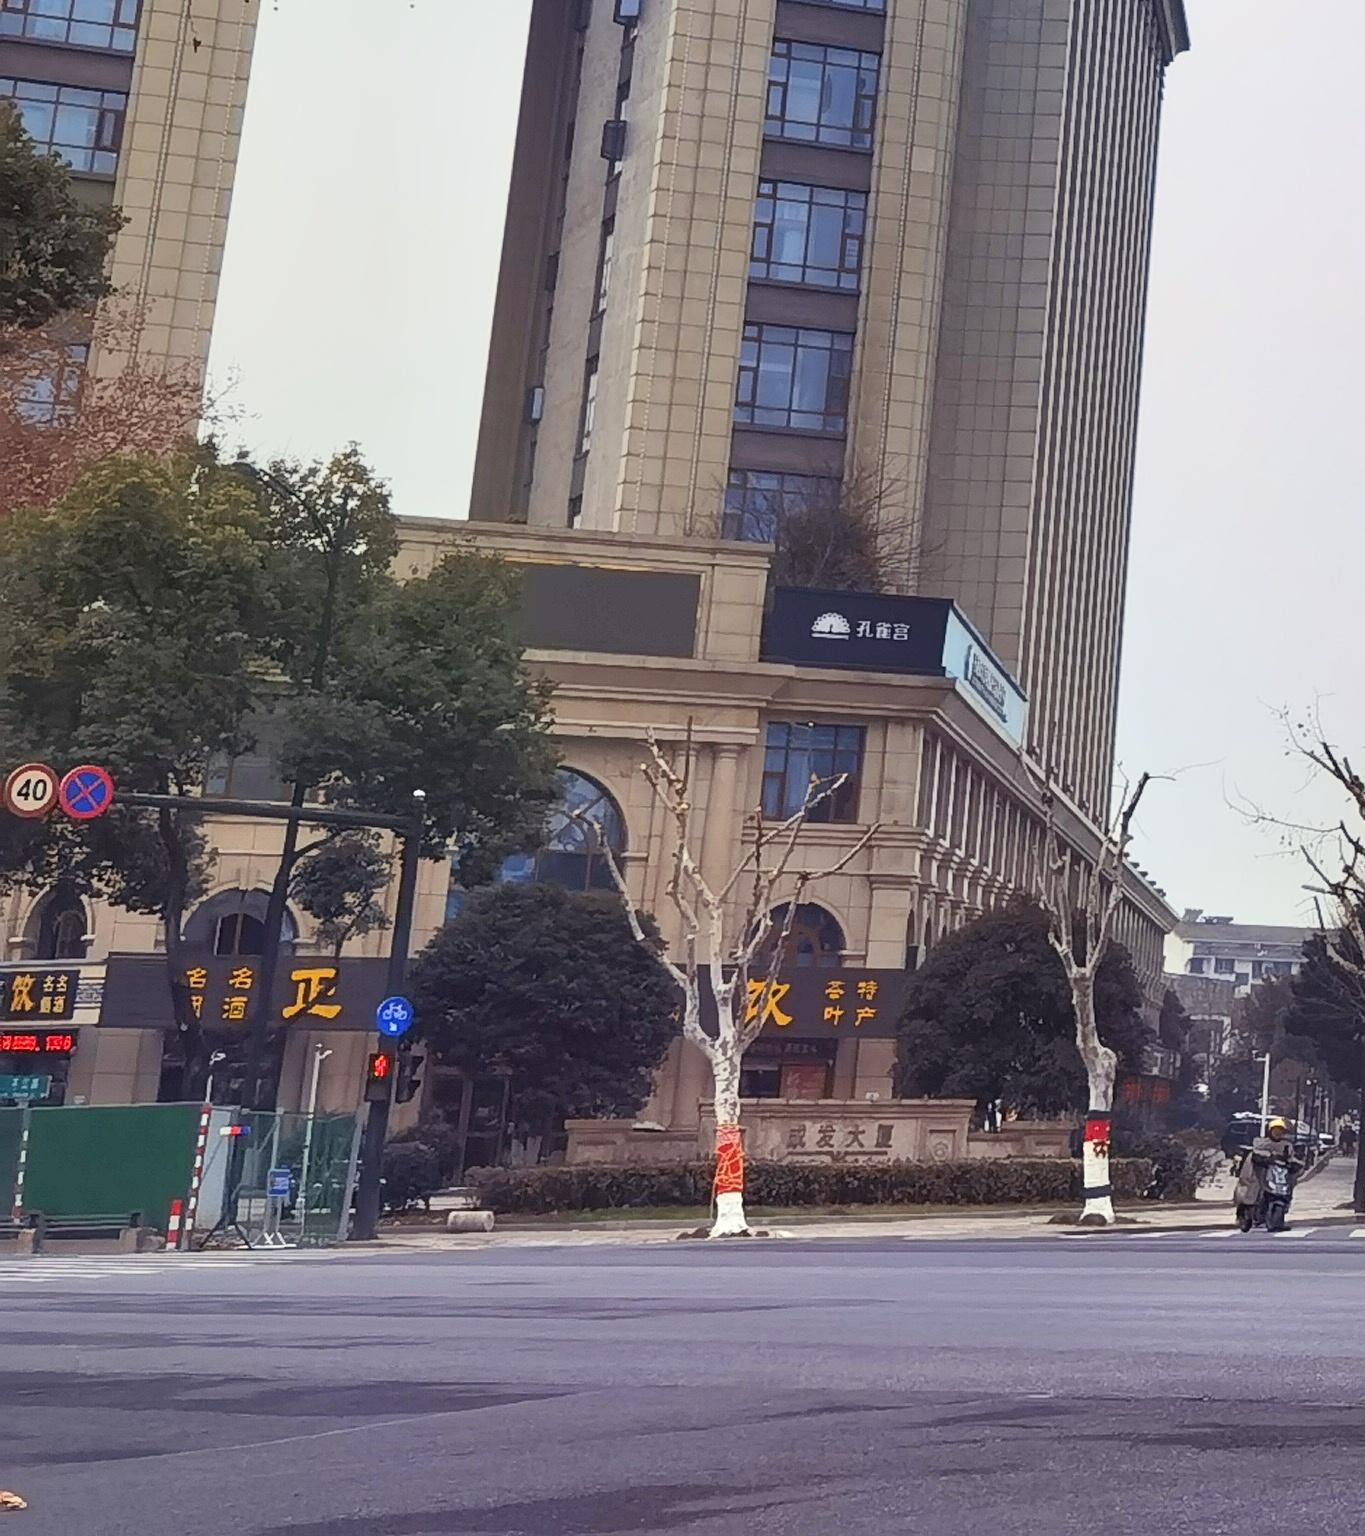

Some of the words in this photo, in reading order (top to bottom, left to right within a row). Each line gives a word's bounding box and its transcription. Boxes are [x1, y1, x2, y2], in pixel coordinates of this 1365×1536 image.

[856, 620, 911, 641] 孔雀宫
[17, 778, 47, 801] 40
